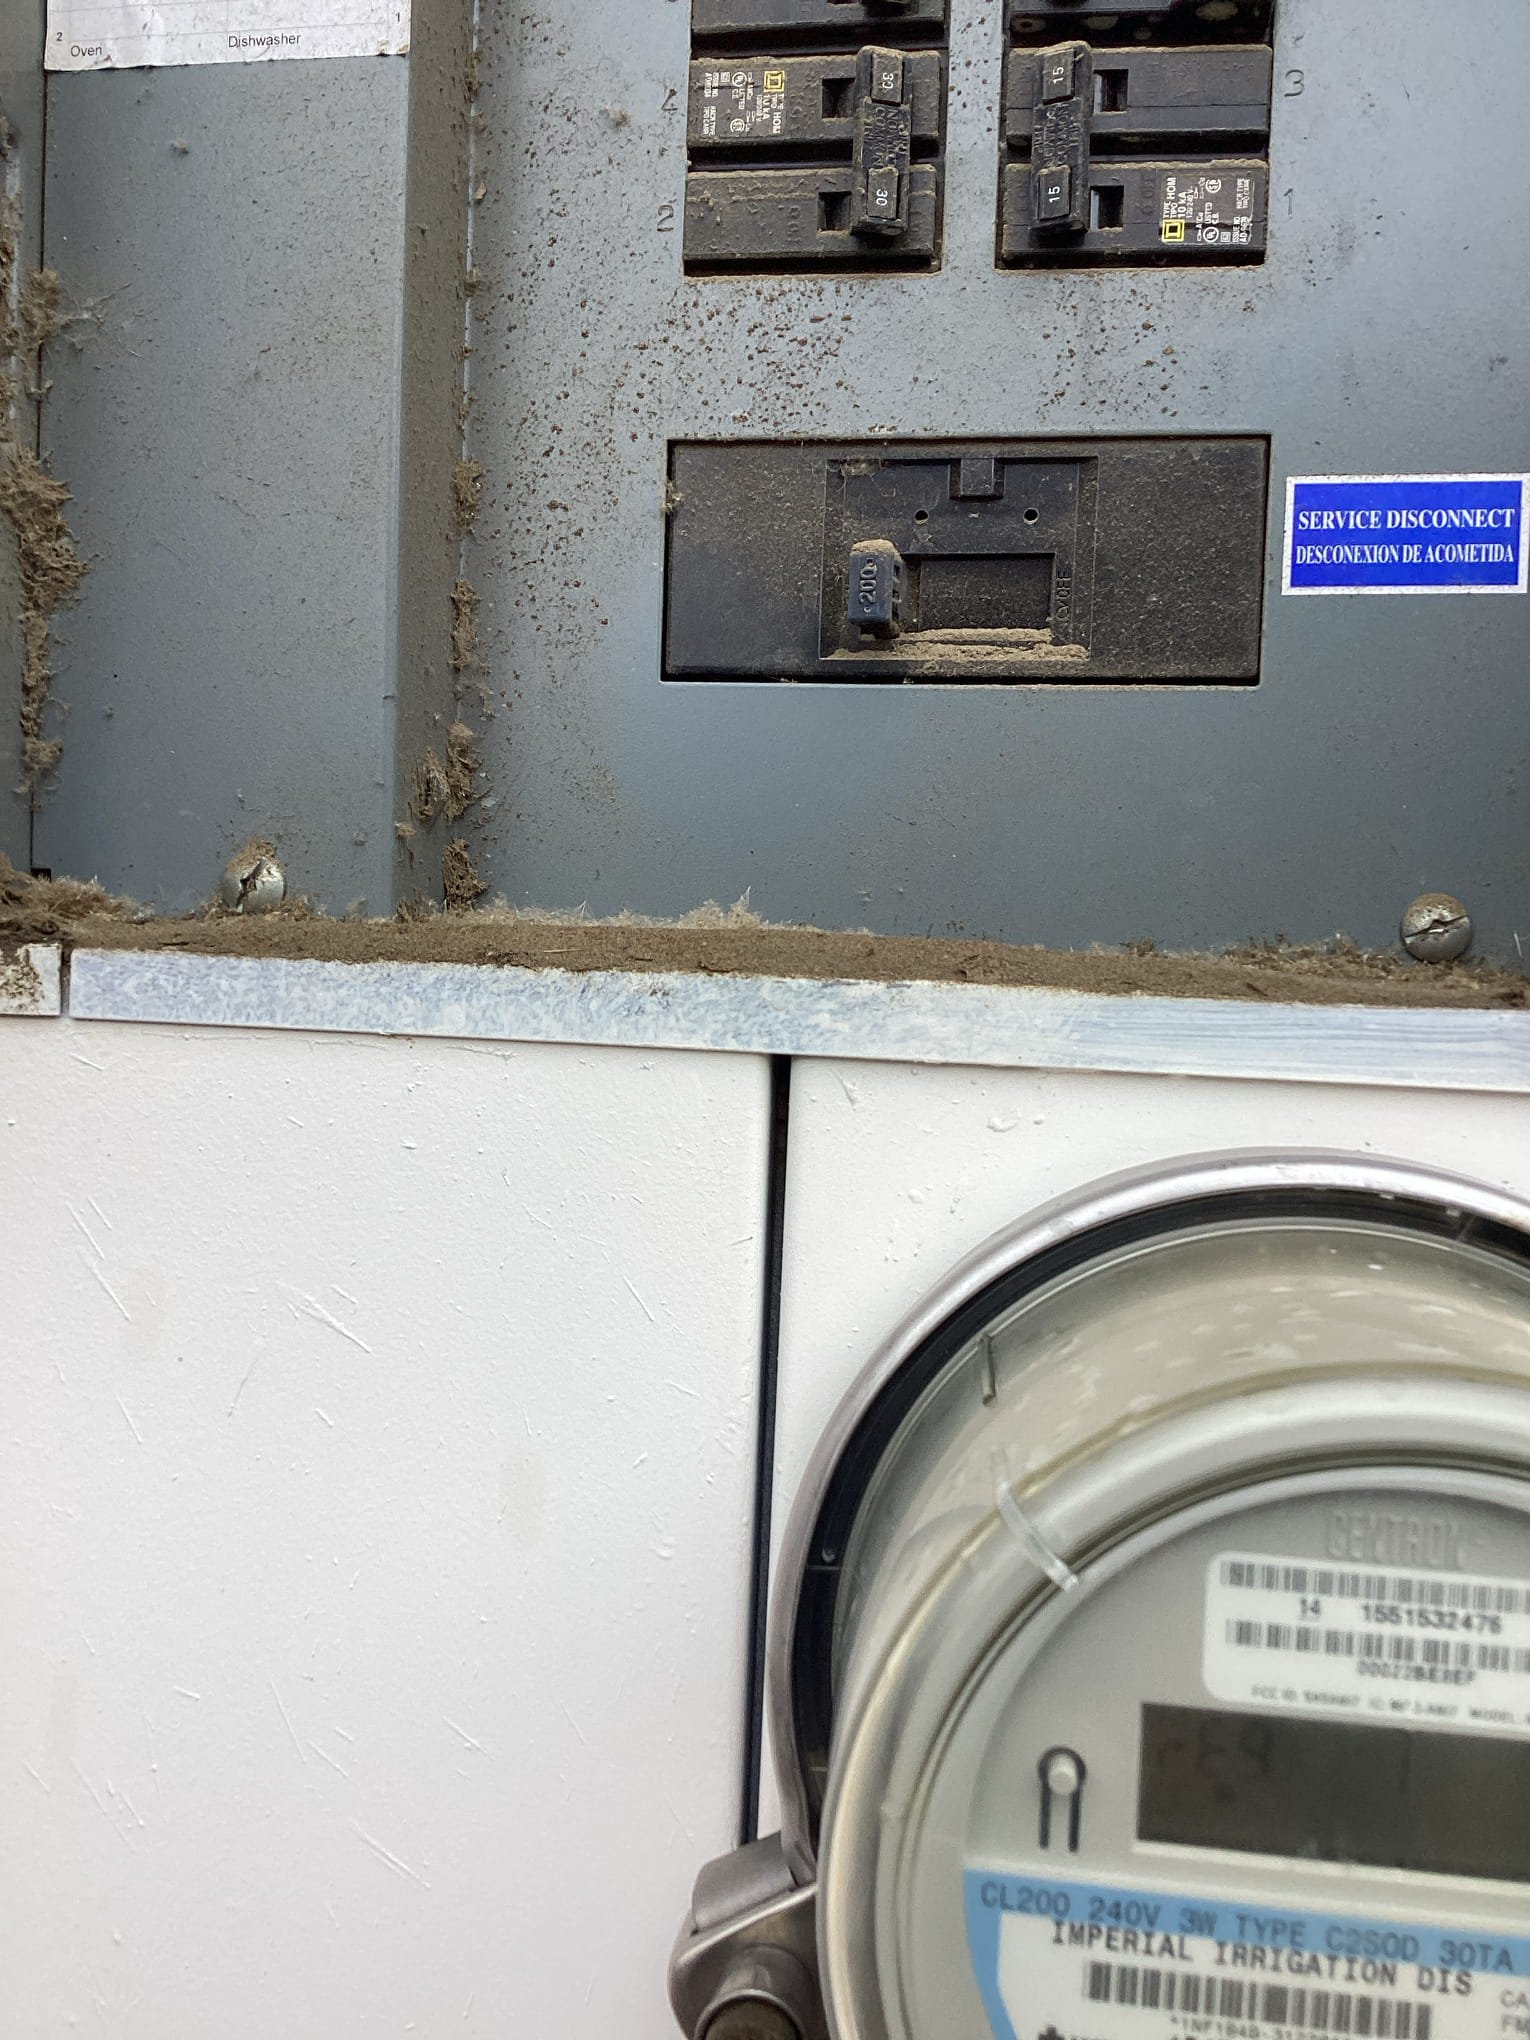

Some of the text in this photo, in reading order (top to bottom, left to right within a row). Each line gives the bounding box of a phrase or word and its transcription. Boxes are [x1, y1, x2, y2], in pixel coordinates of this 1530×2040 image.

[56, 31, 63, 42] 2
[228, 32, 302, 49] Dishwasher
[70, 44, 103, 58] Oven
[881, 72, 894, 90] 30
[1052, 66, 1065, 84] 15
[1283, 69, 1305, 98] 3
[875, 188, 888, 207] 30
[1049, 185, 1061, 204] 15
[1167, 177, 1176, 200] HOM
[1178, 192, 1186, 217] 10 kA
[656, 204, 675, 232] 2
[1298, 508, 1515, 530] SERVICE DISCONNECT
[1296, 543, 1514, 564] DESCONEXION DE ACOMETIDA
[859, 564, 878, 604] 200
[1300, 1597, 1321, 1617] 14
[980, 1880, 1071, 1918] CL200
[1088, 1895, 1162, 1928] 240V
[1179, 1907, 1218, 1935] 3W
[1236, 1912, 1307, 1948] TYPE
[1438, 1939, 1514, 1971] 30TA
[1052, 1919, 1472, 1996] IMPERIAL IRRIGATION DIS
